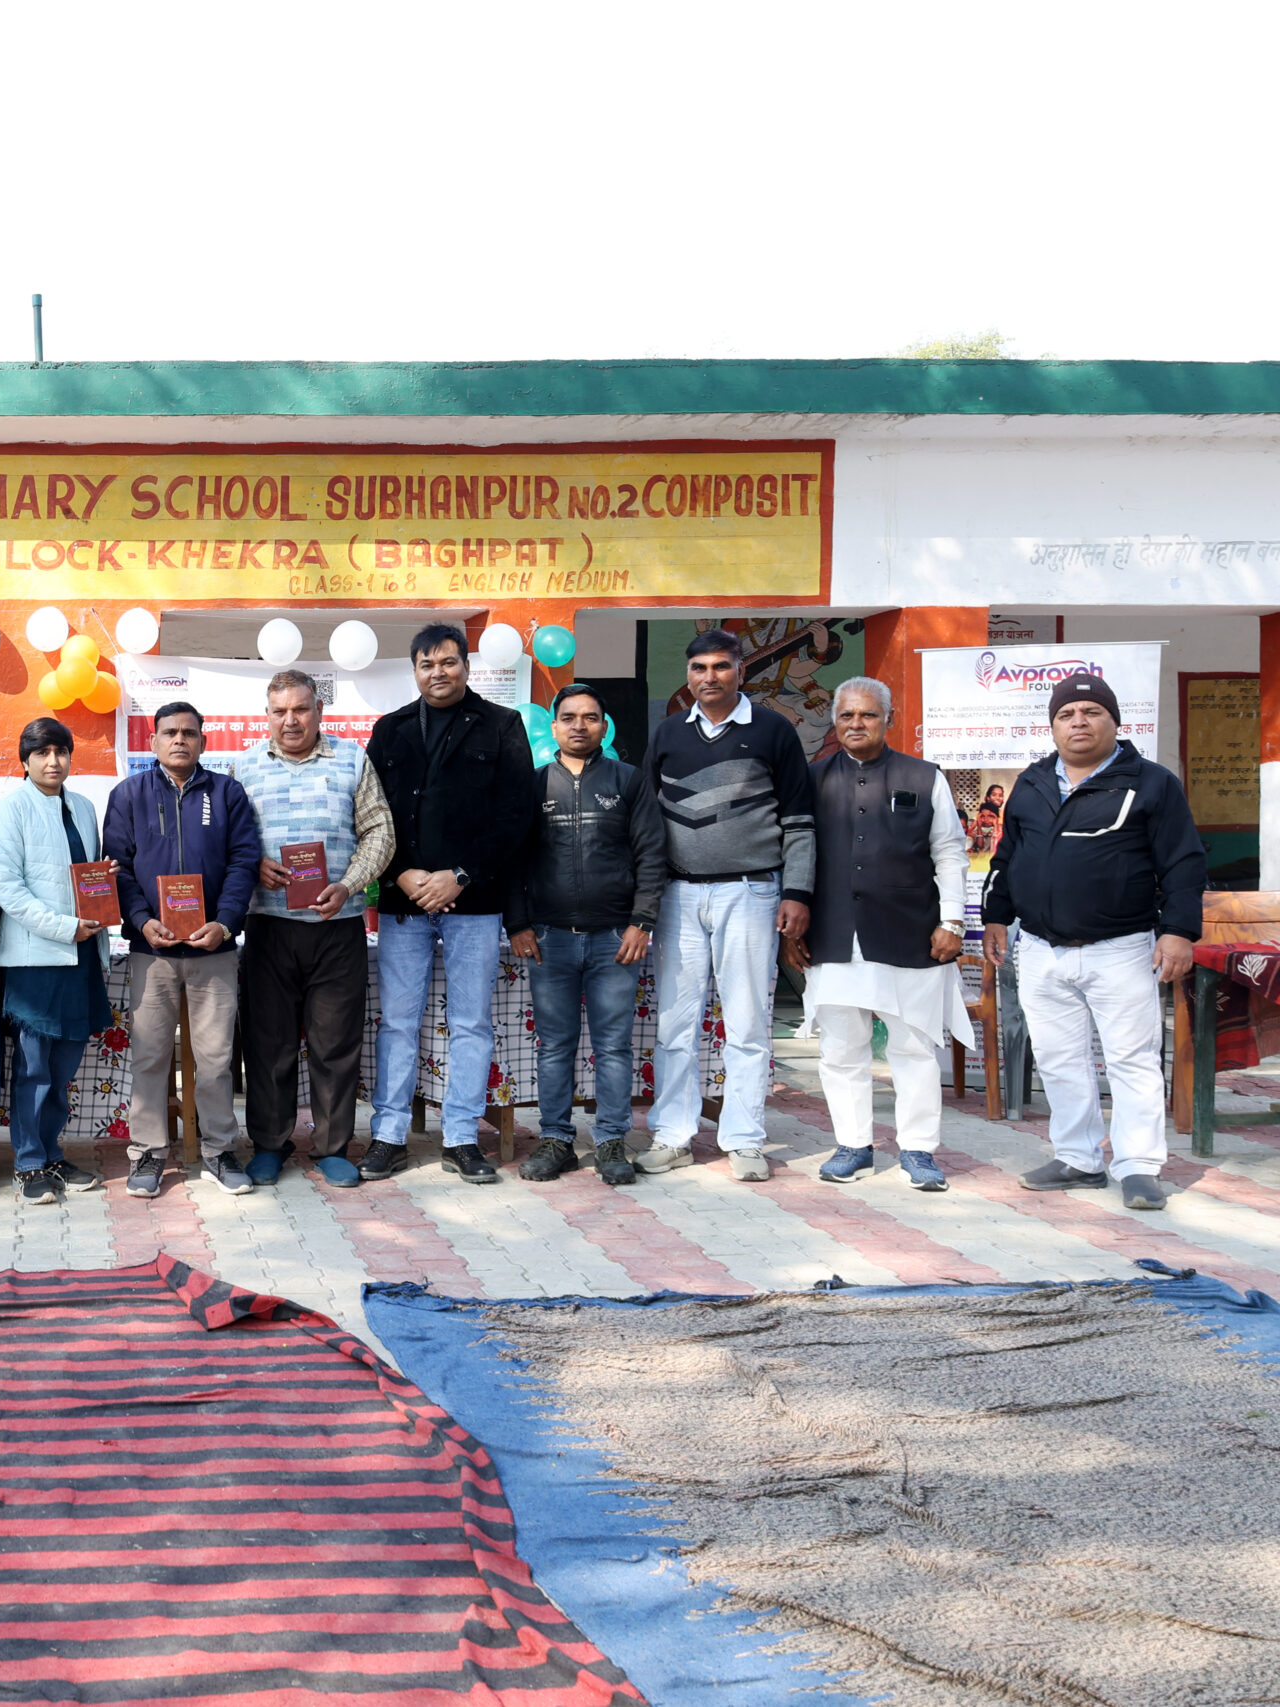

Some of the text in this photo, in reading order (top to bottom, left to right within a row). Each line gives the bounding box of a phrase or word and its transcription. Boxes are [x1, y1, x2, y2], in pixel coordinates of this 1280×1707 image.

[130, 474, 308, 521] SCHOOL
[325, 474, 562, 521] SUBHANPUR
[642, 473, 819, 519] COMPOSIT
[447, 571, 532, 593] ENGLISH
[229, 721, 244, 732] का
[927, 727, 962, 739] अवप्रवाह
[1011, 726, 1027, 738] एक
[1030, 722, 1052, 737] बेहत
[1135, 723, 1155, 735] साथ
[201, 792, 211, 826] JORDAN
